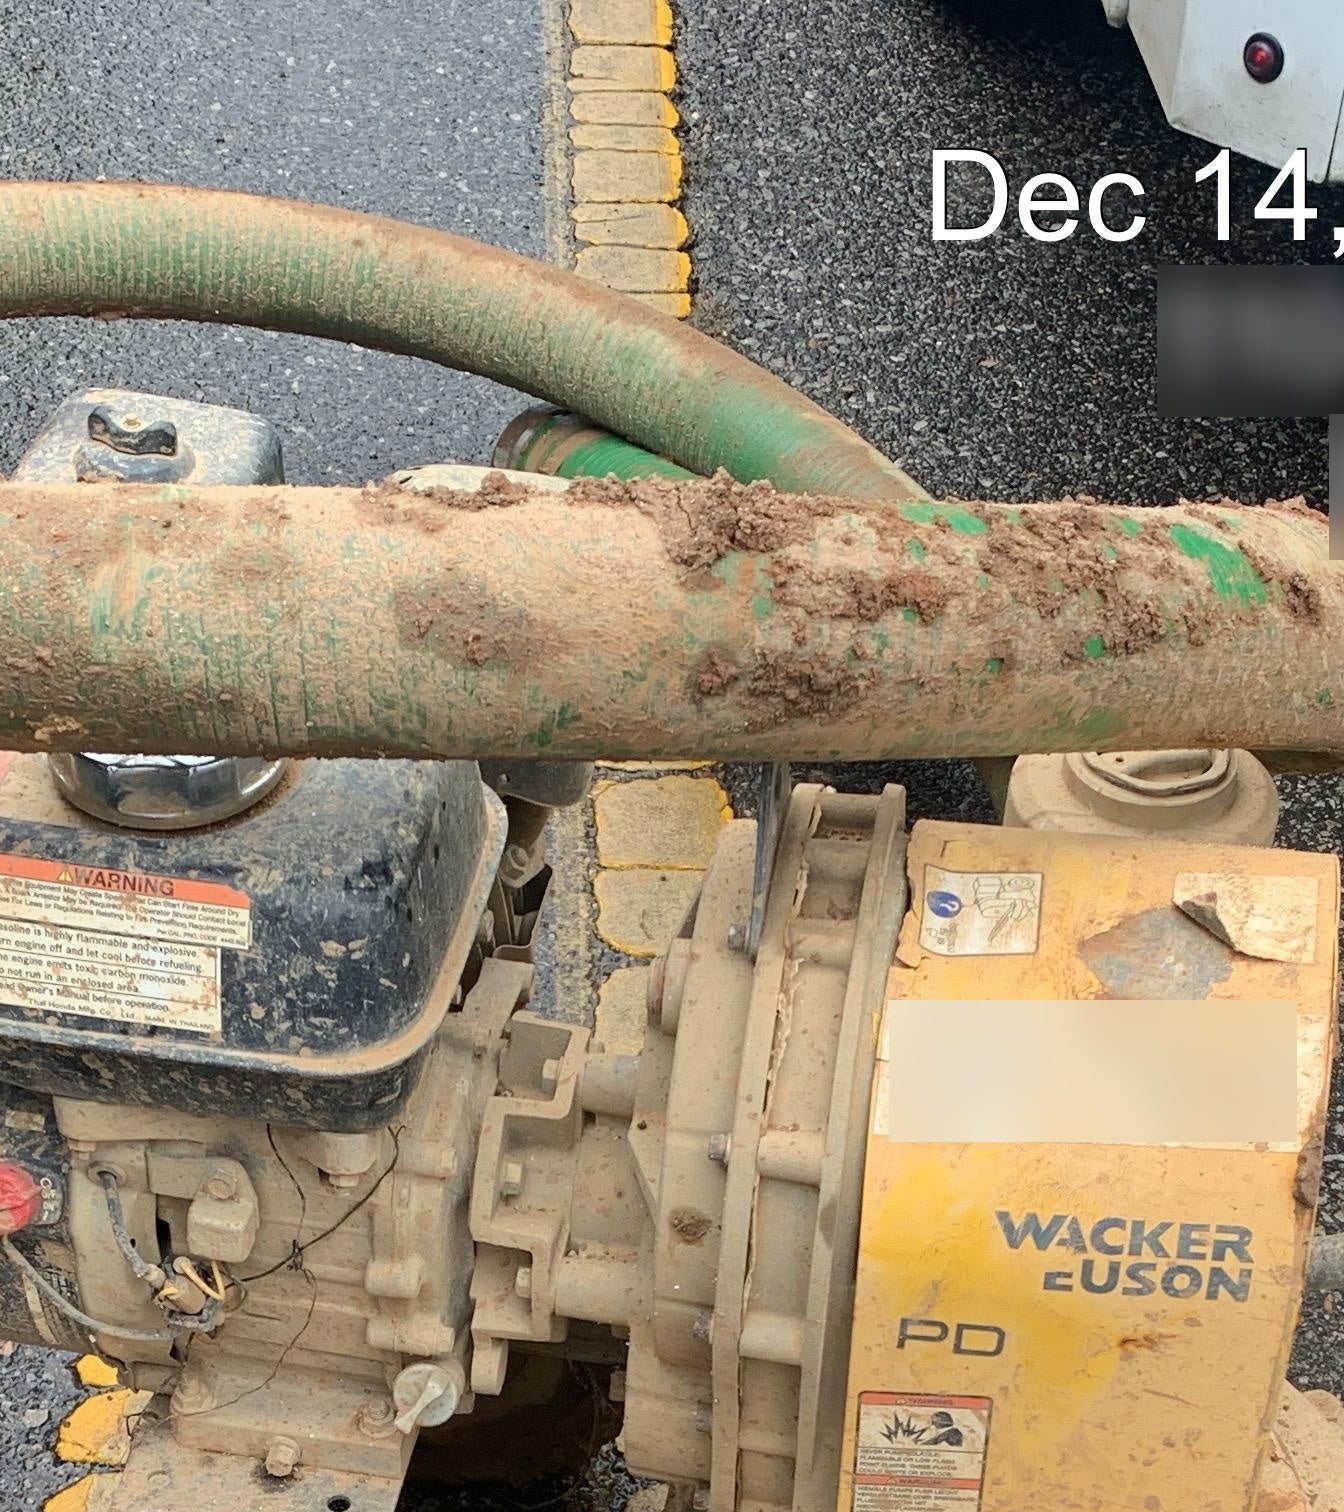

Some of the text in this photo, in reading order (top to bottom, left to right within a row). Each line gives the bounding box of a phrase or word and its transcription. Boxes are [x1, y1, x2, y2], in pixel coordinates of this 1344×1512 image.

[73, 868, 175, 896] WARNING
[12, 896, 23, 905] For
[25, 899, 43, 908] Laws
[53, 903, 94, 915] Regulations
[95, 908, 124, 920] Relating
[135, 914, 148, 923] Fire
[150, 917, 187, 929] Prevention
[24, 880, 61, 892] Equipment
[63, 886, 78, 896] May
[147, 898, 162, 907] Can
[163, 900, 180, 909] Start
[182, 903, 199, 911] Fires
[201, 905, 226, 915] Around
[227, 908, 239, 918] Dry
[33, 891, 61, 901] Arrestor
[62, 894, 77, 905] May
[78, 897, 88, 905] be
[139, 905, 170, 917] Operator
[171, 909, 196, 919] Should
[198, 912, 225, 924] Contact
[227, 916, 246, 926] Local
[34, 928, 41, 936] is
[45, 929, 73, 942] highly
[76, 931, 128, 948] flammable
[131, 941, 148, 952] and
[12, 955, 43, 967] engine
[46, 960, 72, 970] emits
[76, 963, 98, 974] toxic
[102, 968, 136, 980] carbon
[139, 973, 188, 986] monoxide.
[15, 939, 46, 951] engine
[50, 943, 62, 953] off
[66, 947, 83, 956] and
[86, 948, 98, 958] let
[102, 952, 122, 961] cool
[125, 954, 157, 966] before
[159, 958, 204, 974] refueling.
[7, 967, 22, 977] not
[25, 970, 41, 979] run
[44, 972, 53, 981] in
[56, 975, 68, 983] an
[71, 976, 114, 990] enclosed
[116, 982, 141, 993] area.
[18, 983, 54, 996] Owner's
[56, 988, 90, 1000] Manual
[93, 992, 122, 1005] before
[48, 1001, 76, 1011] Honda
[42, 1201, 56, 1211] ON
[995, 1210, 1255, 1264] WACKER
[896, 1318, 1006, 1357] PD
